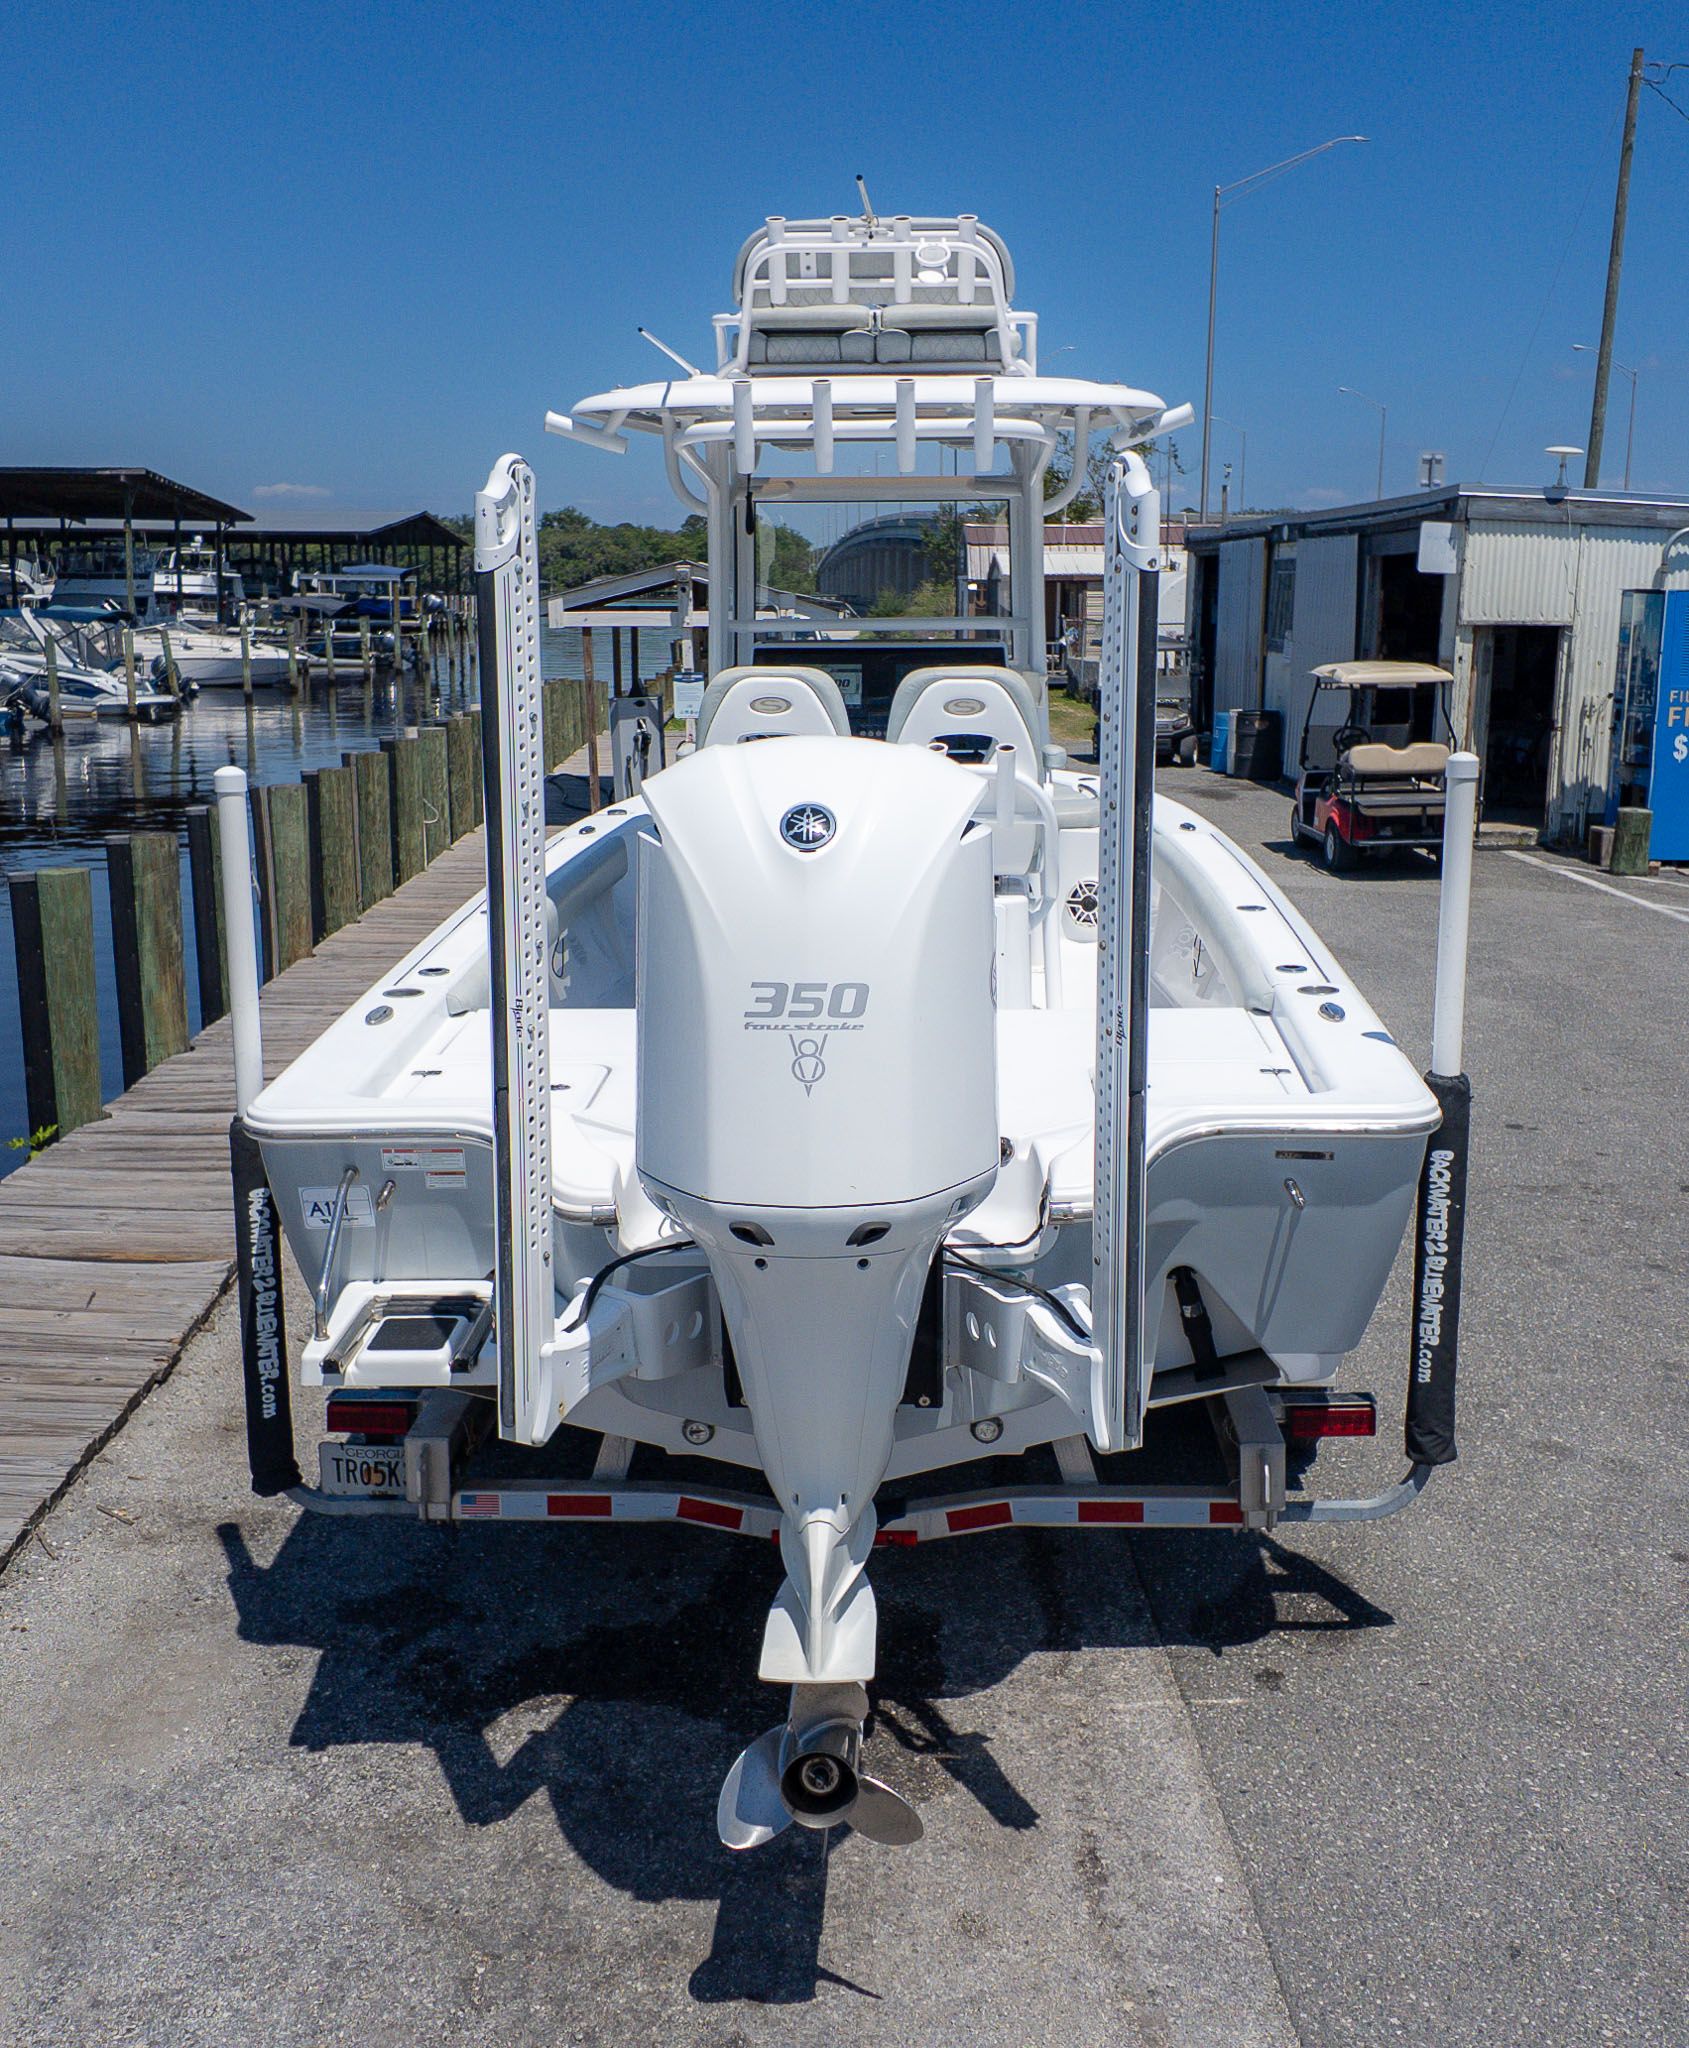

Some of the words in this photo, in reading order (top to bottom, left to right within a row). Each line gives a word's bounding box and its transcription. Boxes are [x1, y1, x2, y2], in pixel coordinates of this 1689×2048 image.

[744, 981, 870, 1018] 350
[743, 1021, 865, 1031] fourstroke
[332, 1457, 407, 1487] TR05K
